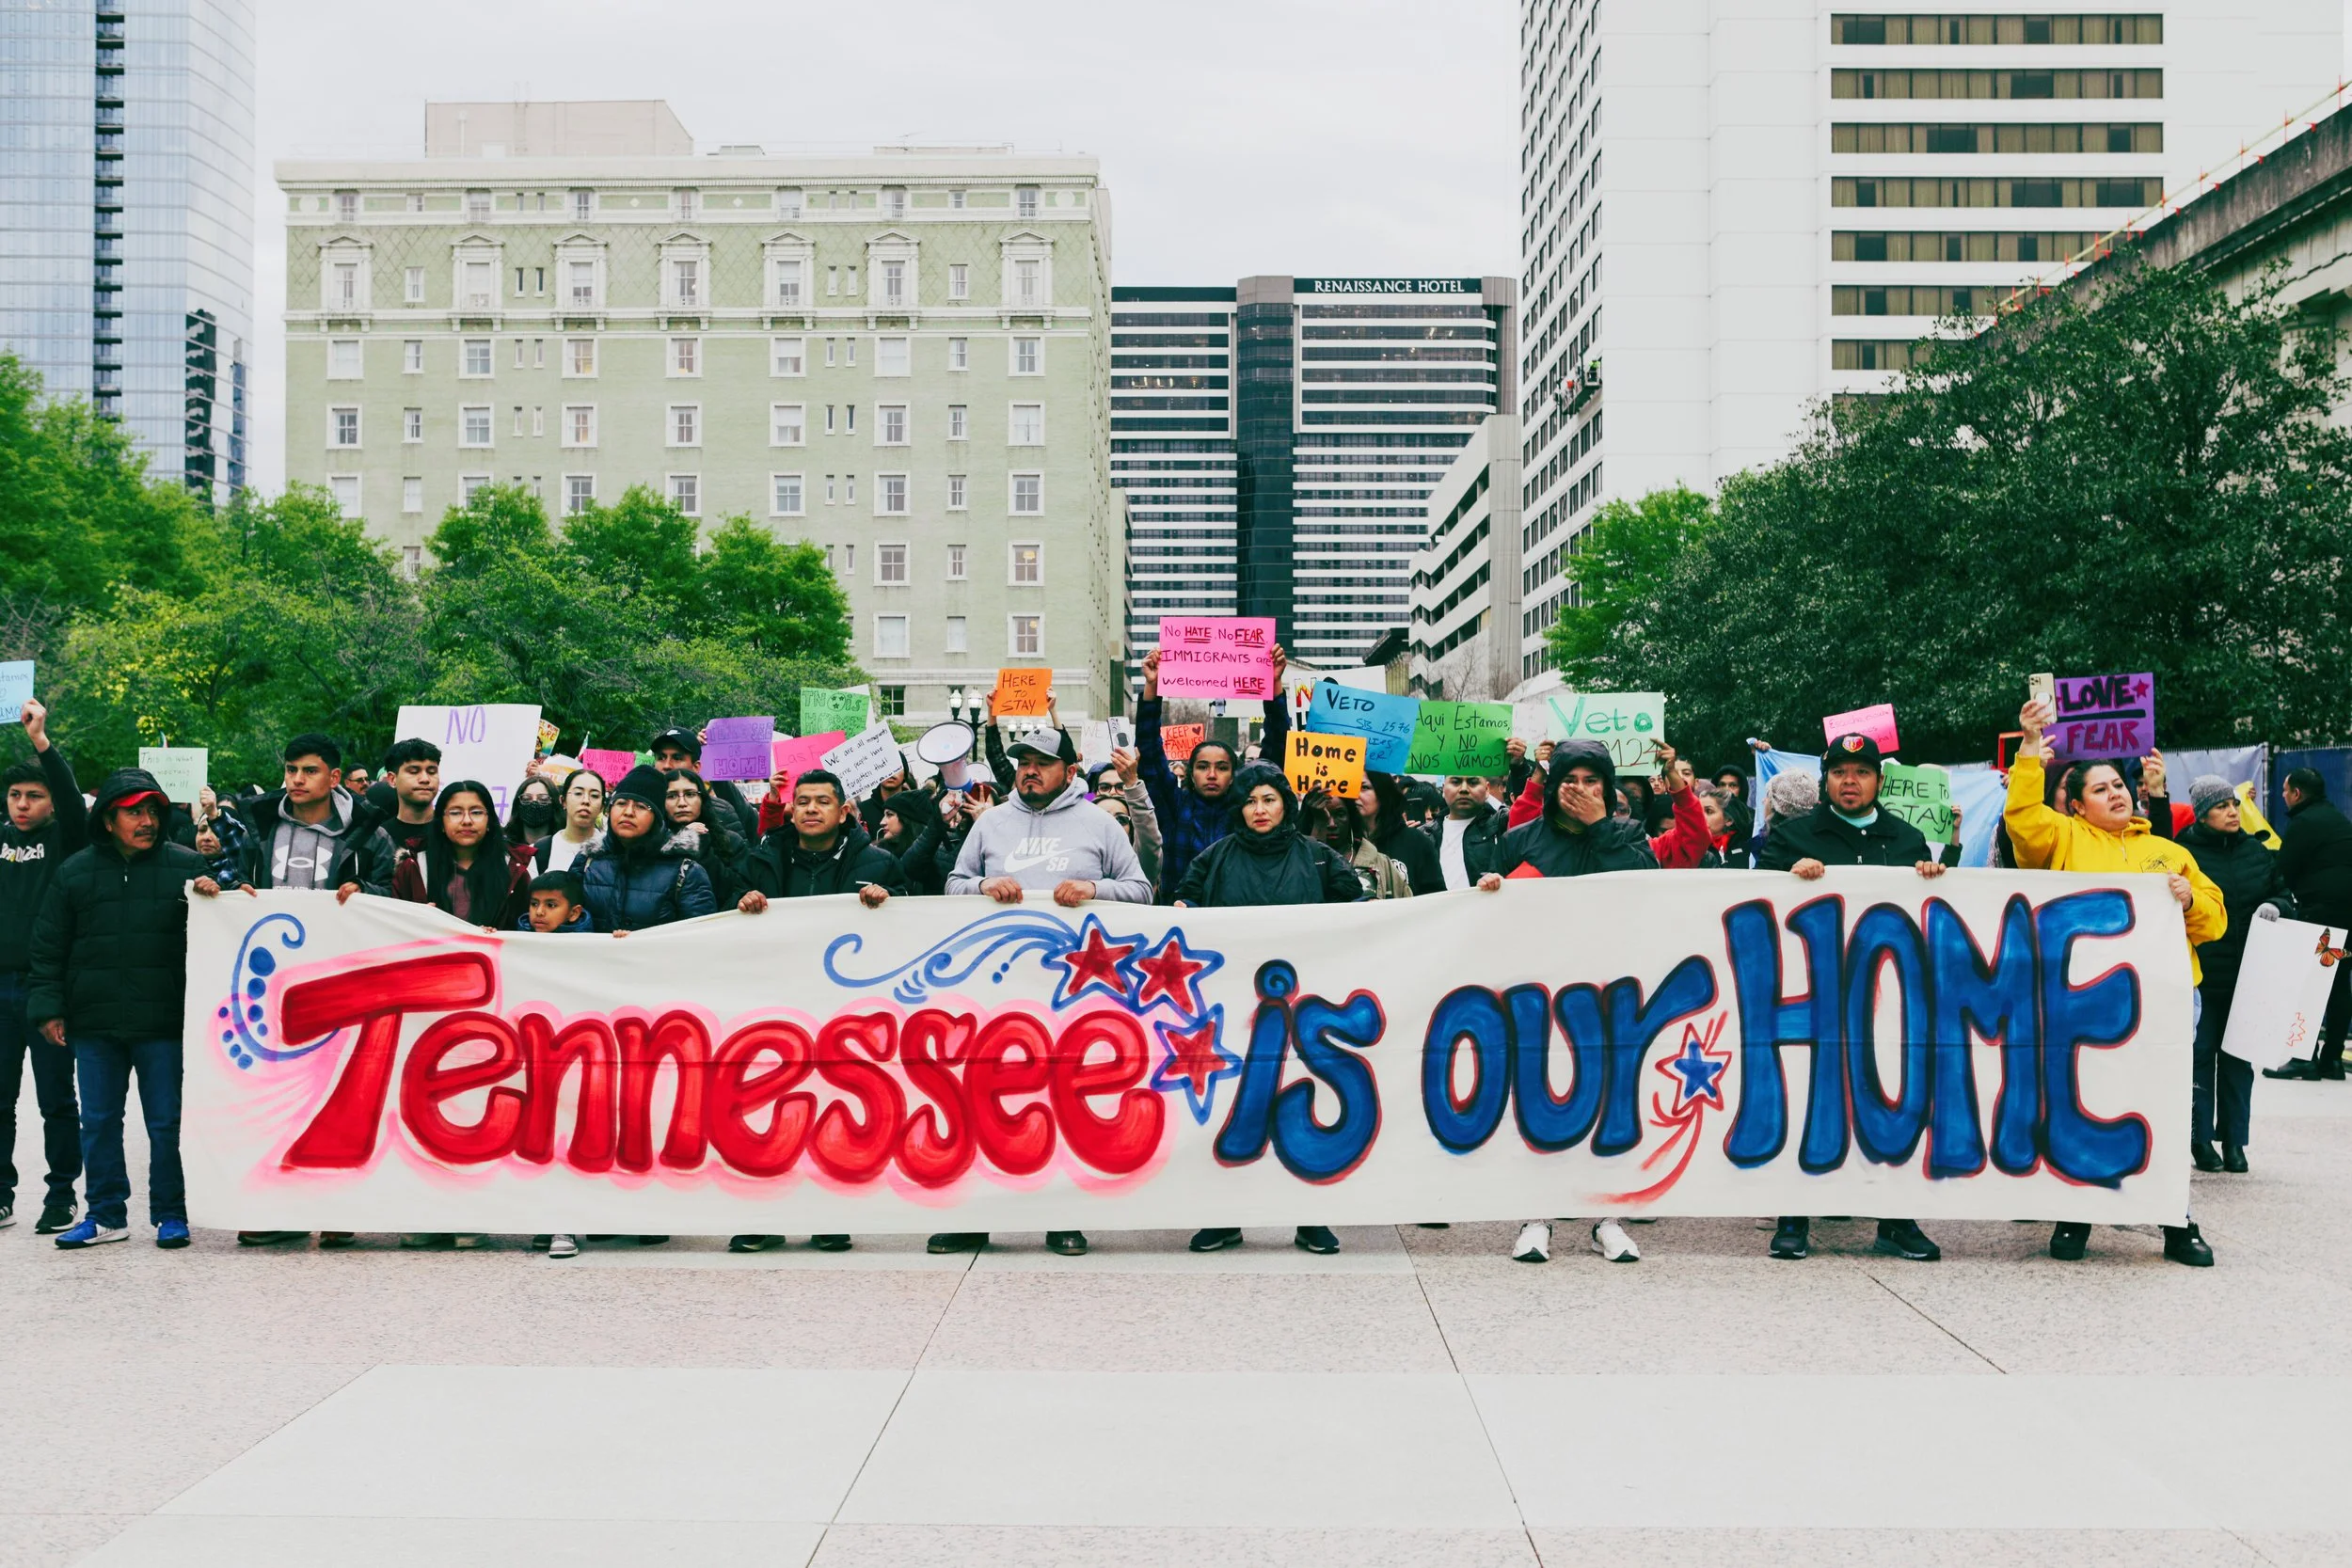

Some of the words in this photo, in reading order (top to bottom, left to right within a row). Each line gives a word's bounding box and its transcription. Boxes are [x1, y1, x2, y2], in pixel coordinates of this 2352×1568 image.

[1314, 280, 1412, 293] RENAISSANCE
[1418, 280, 1465, 293] HOTEL
[1165, 625, 1181, 638] No
[1161, 649, 1251, 664] IMMIGRANTS
[1256, 657, 1272, 667] are
[1002, 672, 1037, 689] HERE
[1162, 676, 1228, 689] welcomed
[1233, 676, 1266, 690] HERE
[802, 690, 827, 707] TN
[845, 693, 863, 711] is
[1013, 689, 1028, 698] TO
[1326, 688, 1375, 712] VETO
[2059, 675, 2136, 712] LOVE
[1000, 699, 1037, 715] STAY
[446, 705, 486, 745] NO
[1548, 696, 1653, 737] Veto
[1167, 725, 1190, 739] KEEP
[2066, 721, 2140, 754] FEAR
[1295, 736, 1357, 763] Home
[1458, 734, 1478, 751] NO
[825, 752, 840, 767] We
[843, 746, 854, 757] are
[870, 747, 884, 757] have
[1411, 752, 1440, 770] NOS
[713, 755, 767, 776] HOME
[1315, 762, 1328, 777] is
[1880, 775, 1930, 799] HERE
[1016, 836, 1061, 855] NIKE
[1046, 856, 1070, 872] SB
[281, 949, 1167, 1190] Tennessee
[1212, 958, 1389, 1187] is
[1422, 953, 1719, 1159] our
[1721, 888, 2153, 1190] HOME
